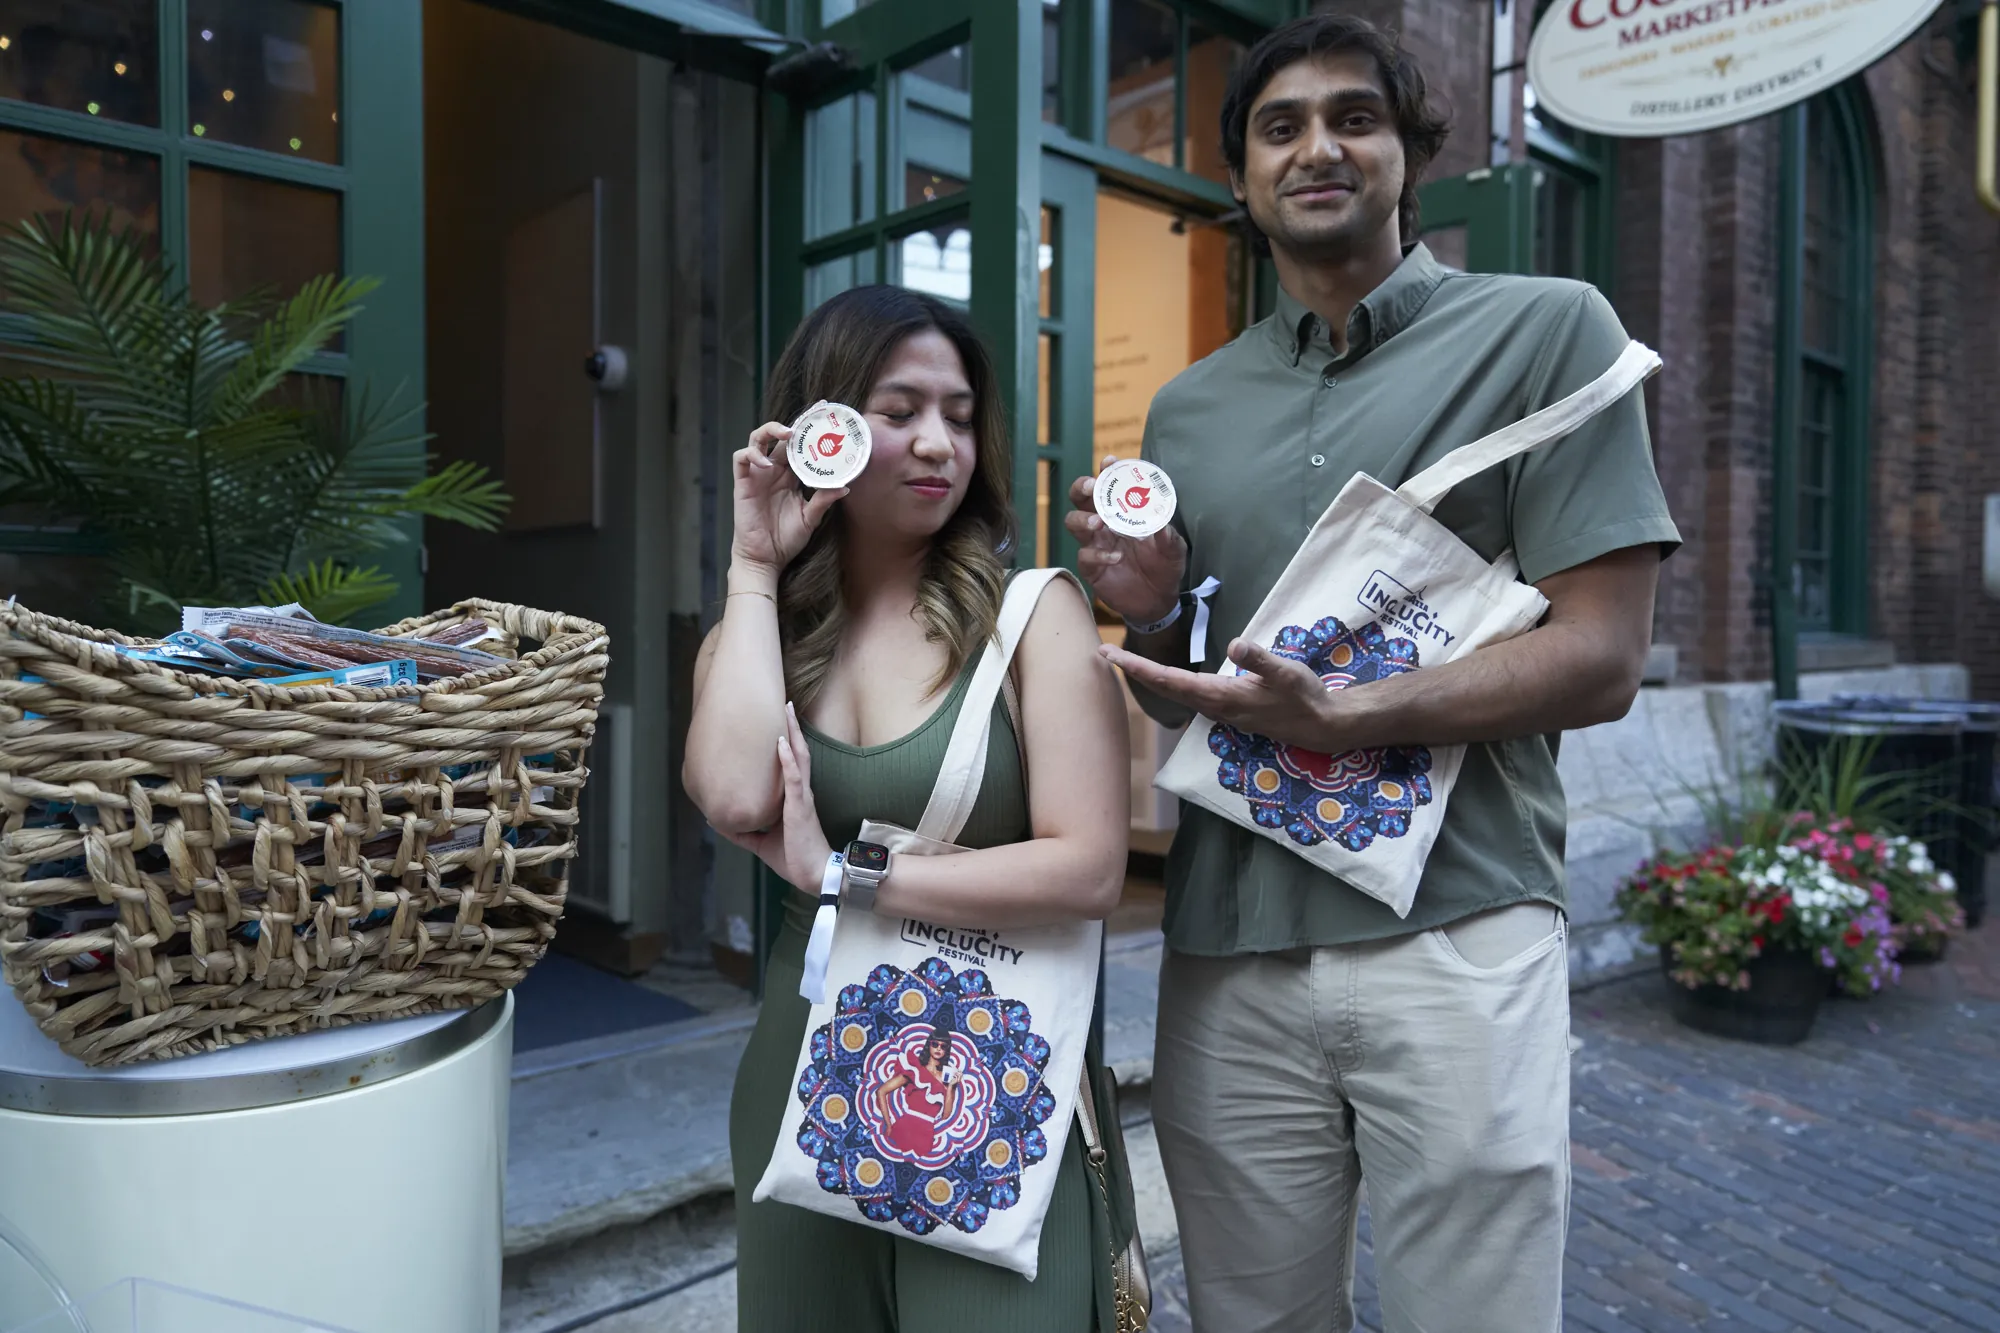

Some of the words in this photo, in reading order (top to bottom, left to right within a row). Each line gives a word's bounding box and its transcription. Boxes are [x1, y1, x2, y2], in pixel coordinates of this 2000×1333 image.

[1629, 91, 1727, 118] DISTILLERY
[1734, 56, 1826, 101] DISTRICT
[802, 422, 814, 434] Hot
[797, 433, 807, 454] Honey
[803, 460, 817, 473] Miel
[816, 467, 835, 476] Épicé
[1109, 477, 1119, 488] Hot
[1115, 512, 1128, 523] Miel
[398, 662, 408, 676] 32g
[908, 919, 1024, 966] INCLUCITY
[938, 946, 986, 967] FESTIVAL
